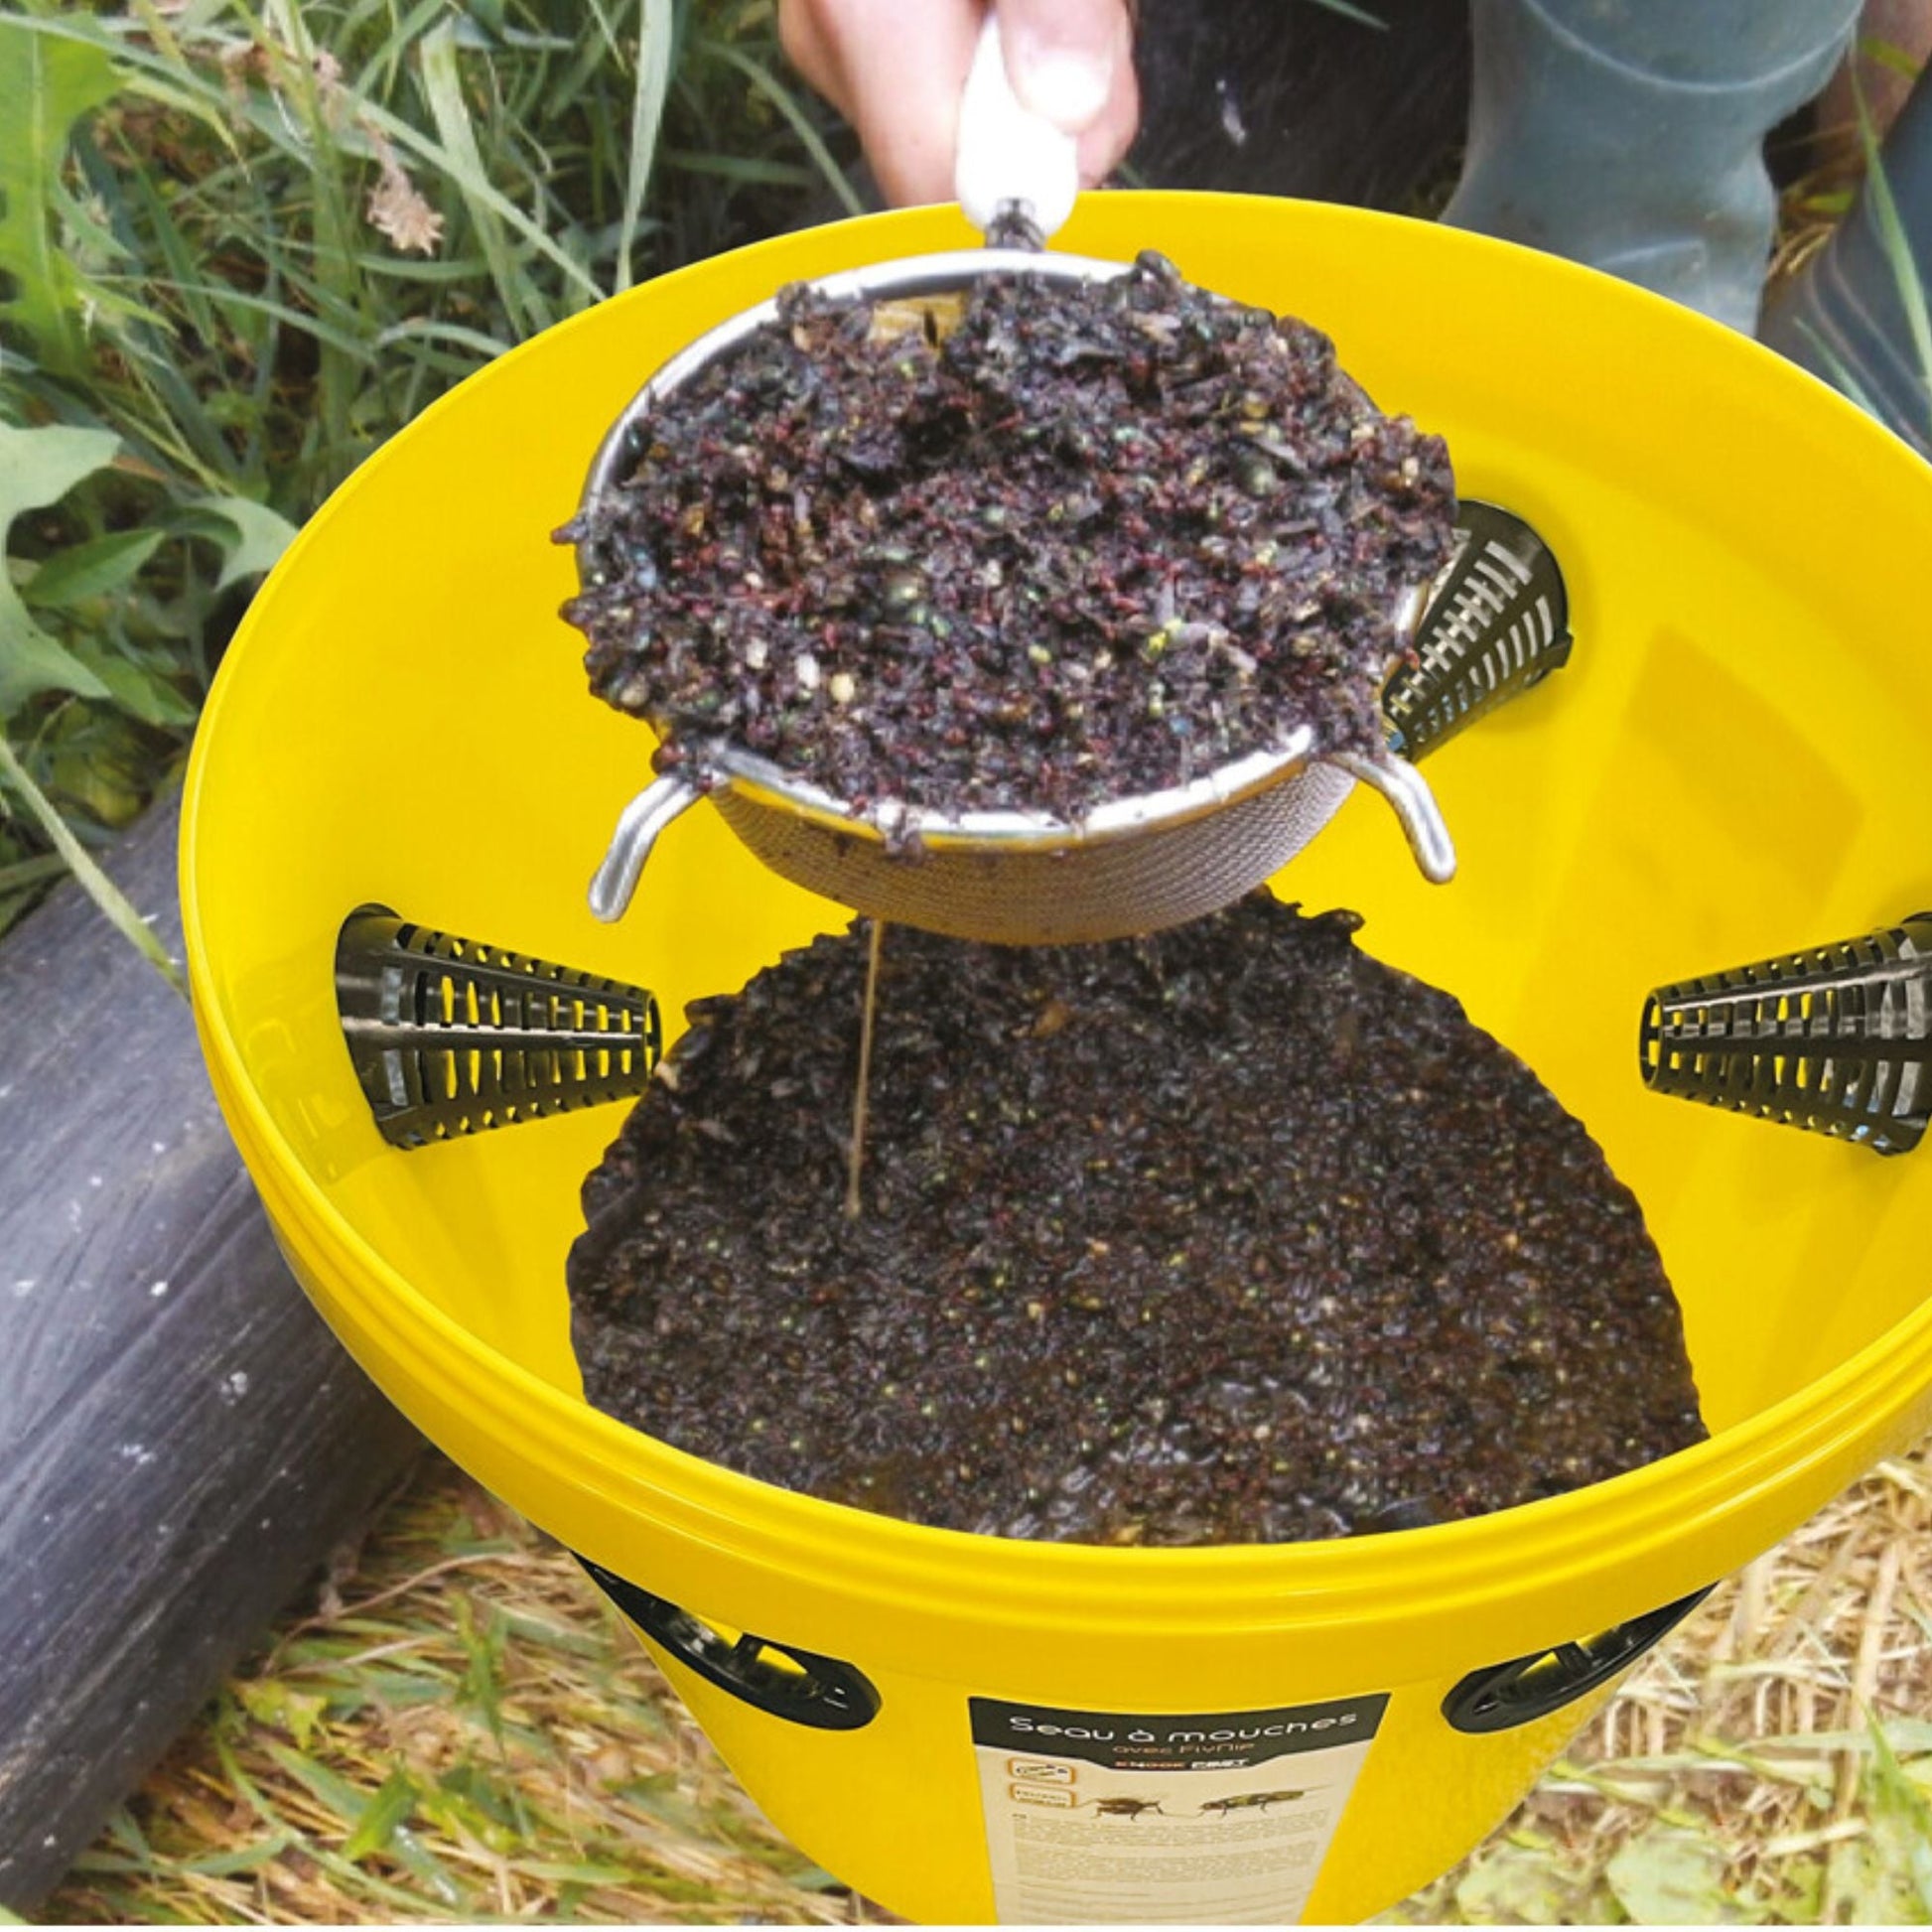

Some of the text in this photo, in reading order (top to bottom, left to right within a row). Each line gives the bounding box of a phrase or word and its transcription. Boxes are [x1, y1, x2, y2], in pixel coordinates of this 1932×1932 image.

[1009, 1713, 1358, 1743] Seau à mouches
[1112, 1744, 1173, 1754] avec
